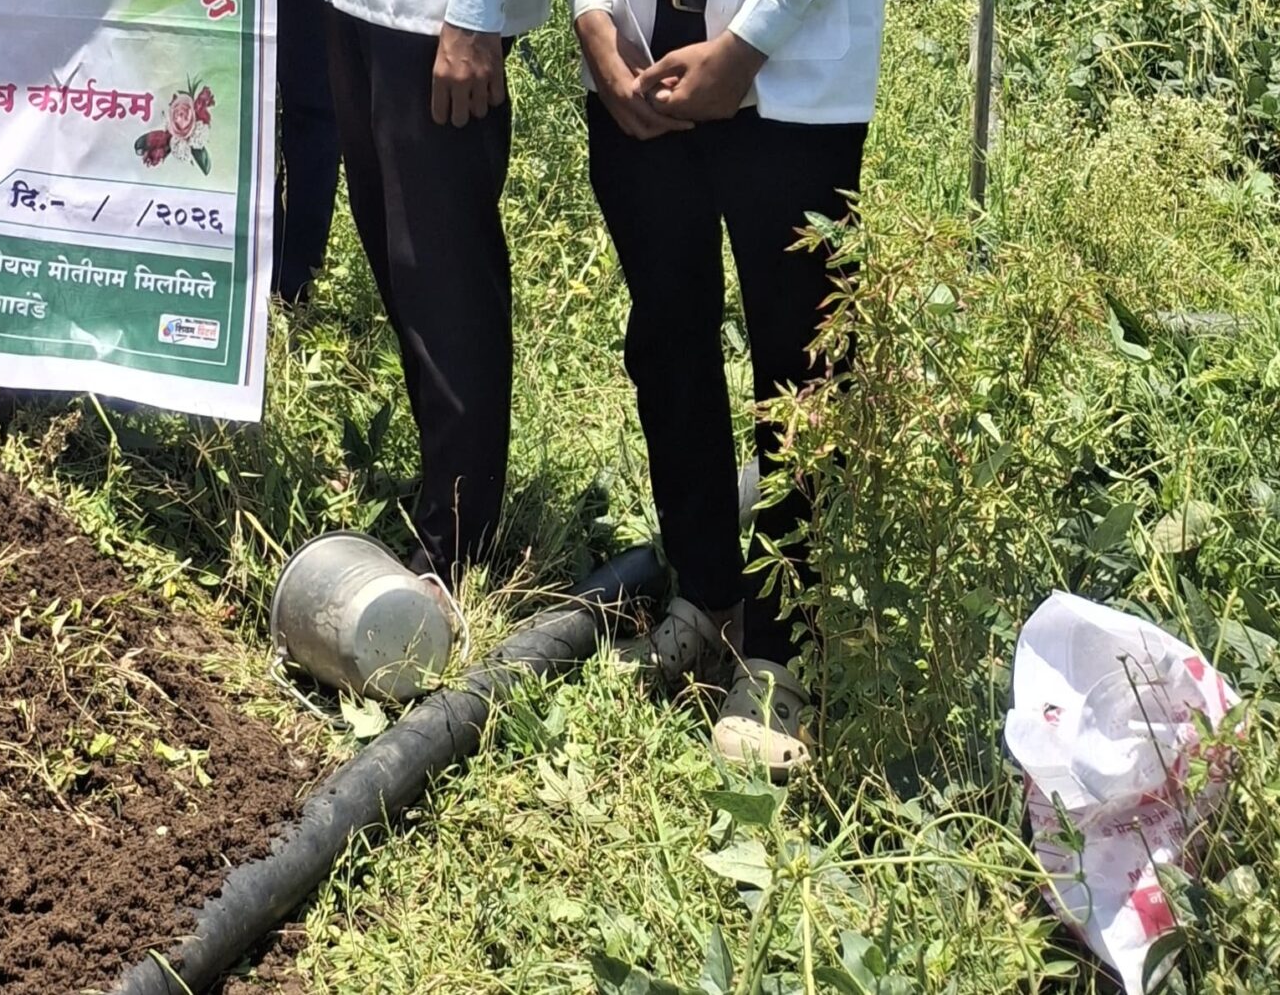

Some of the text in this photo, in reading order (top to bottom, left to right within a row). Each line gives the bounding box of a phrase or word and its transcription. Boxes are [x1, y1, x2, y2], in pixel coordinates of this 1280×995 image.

[27, 79, 154, 122] कार्यक्रम
[48, 254, 127, 288] मोतीराम
[134, 265, 216, 299] मिलमिले
